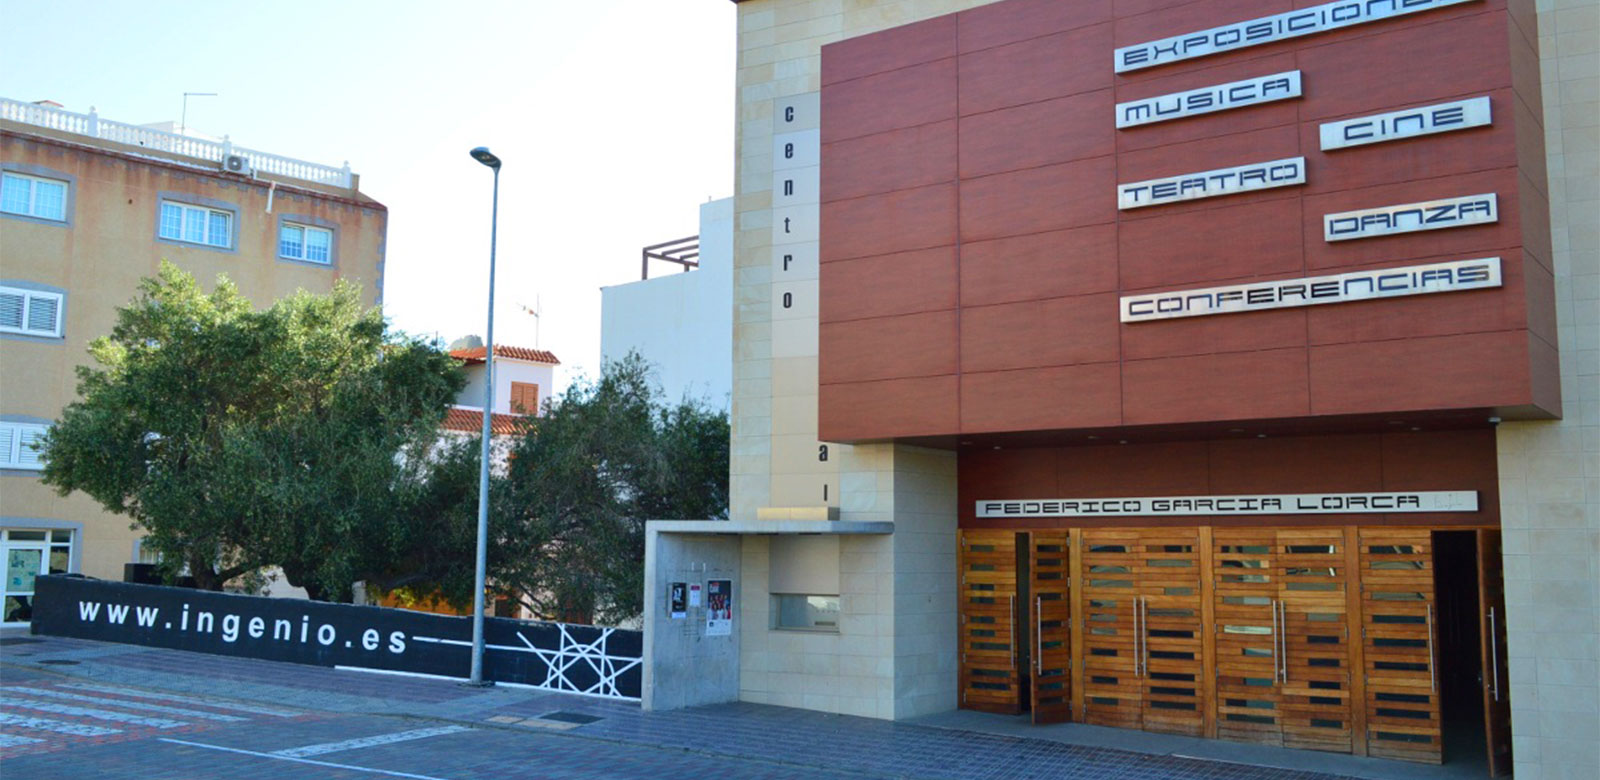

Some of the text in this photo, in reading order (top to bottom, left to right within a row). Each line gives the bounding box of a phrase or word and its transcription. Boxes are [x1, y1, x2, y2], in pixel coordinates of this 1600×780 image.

[1123, 0, 1435, 66] EXPOSICIONE
[1125, 78, 1290, 122] MUSICA
[1344, 106, 1464, 141] CINE
[1124, 163, 1298, 202] TEATRO
[783, 106, 794, 309] centro
[1329, 200, 1491, 235] DANZA
[1128, 265, 1490, 317] CONFERENCIAS
[985, 500, 1141, 514] FEDERICO
[1152, 498, 1281, 512] GARCIA
[1297, 495, 1420, 510] LORCA
[79, 601, 406, 653] www.ingenio.es
